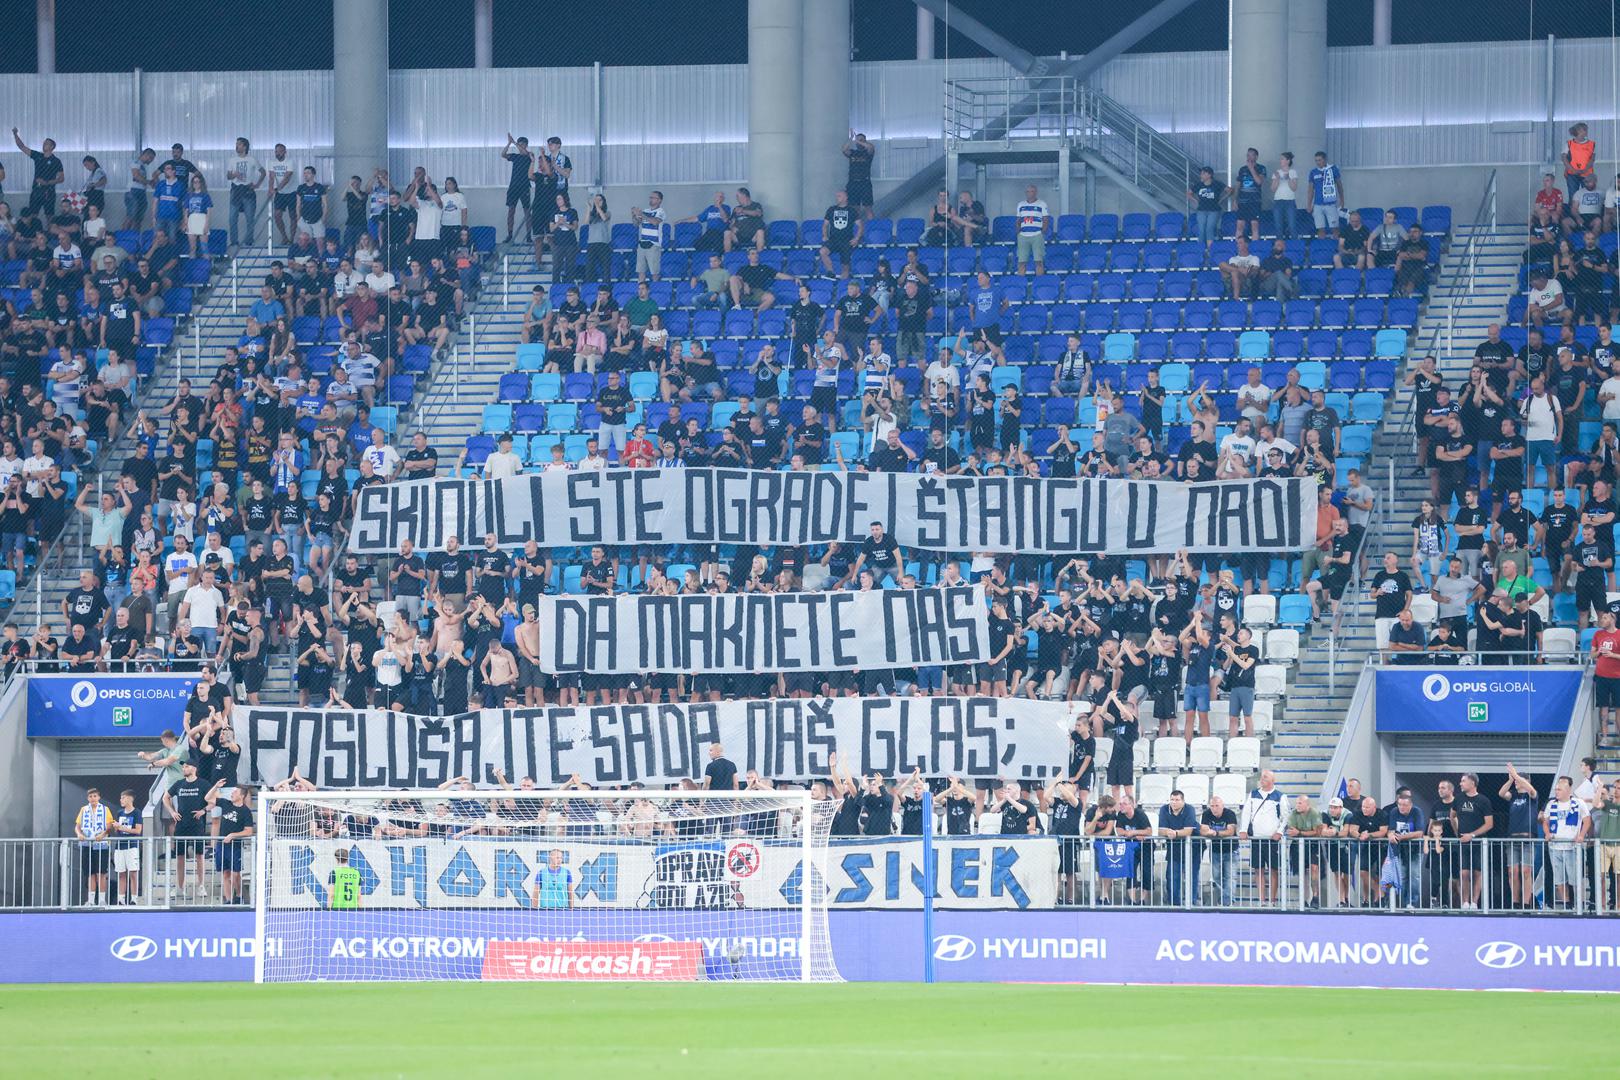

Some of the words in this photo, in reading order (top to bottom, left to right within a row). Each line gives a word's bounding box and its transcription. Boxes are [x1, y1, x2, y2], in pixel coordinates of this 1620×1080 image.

[358, 476, 545, 549] SKINULI
[567, 470, 664, 542] STE
[685, 468, 870, 543] OGRADE
[886, 472, 897, 535] I
[916, 476, 1107, 551] ŠTANGU
[1127, 482, 1158, 548] U
[1185, 478, 1301, 548] NADI
[554, 596, 617, 671] DA
[638, 593, 858, 670] MAKNETE
[883, 587, 976, 663] NAS
[99, 689, 131, 699] OPUS
[133, 689, 176, 699] GLOBAL
[1453, 682, 1487, 692] OPUS
[1489, 682, 1536, 692] GLOBAL
[249, 708, 576, 788] POSLUŠAJTE
[591, 703, 722, 781] SADA
[746, 698, 837, 776] NAŠ
[343, 882, 353, 901] 5
[331, 937, 366, 958] AC
[983, 938, 1107, 959] HYUNDAI
[1155, 940, 1194, 961] AC
[1201, 936, 1430, 965] KOTROMANOVIĆ
[1534, 945, 1620, 966] HYUN
[531, 948, 652, 975] aircash
